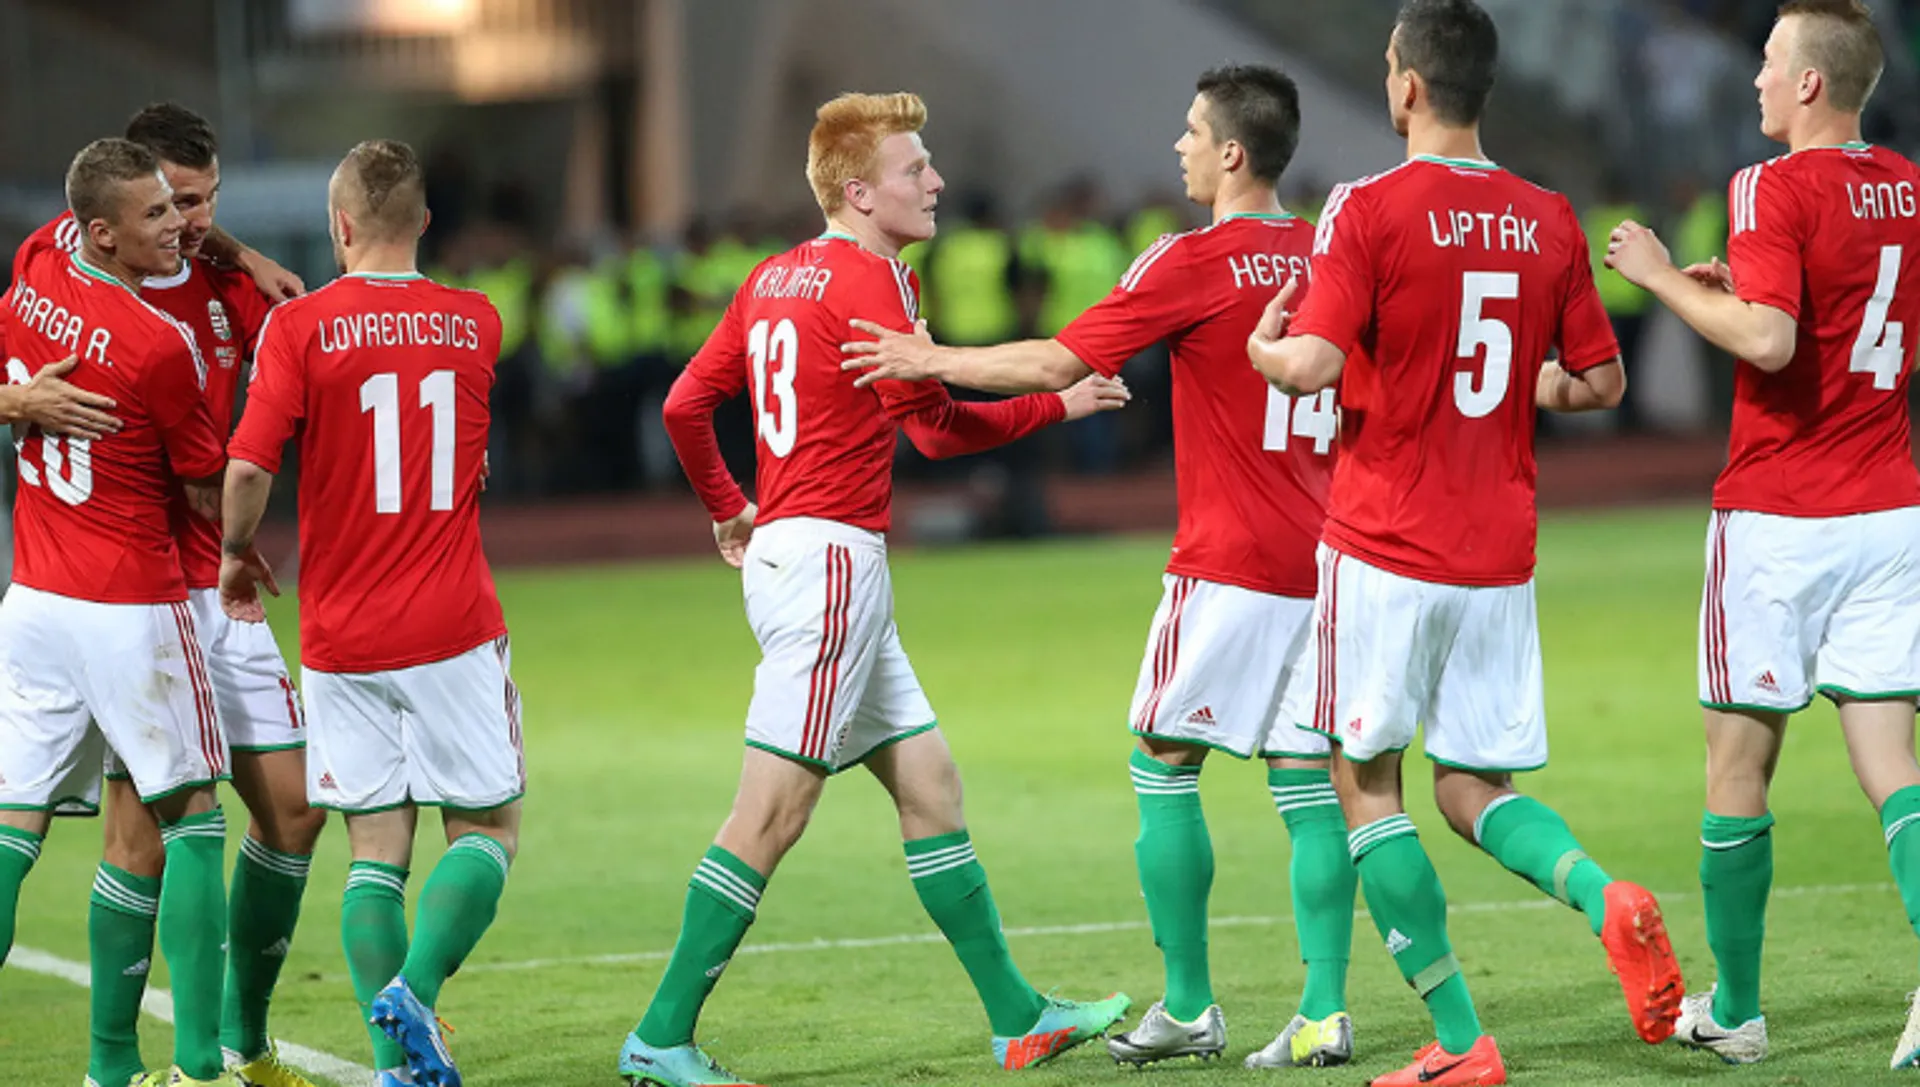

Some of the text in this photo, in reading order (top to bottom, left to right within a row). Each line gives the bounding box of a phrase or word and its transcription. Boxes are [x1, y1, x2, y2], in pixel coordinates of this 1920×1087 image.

[1846, 181, 1917, 219] LANG
[1428, 204, 1540, 255] LIPTÁK
[318, 311, 479, 353] LOVRENCSICS
[1848, 244, 1905, 391] 4
[85, 328, 113, 367] R.
[1453, 271, 1520, 419] 5
[748, 318, 799, 458] 13
[359, 370, 456, 514] 11
[1004, 1025, 1077, 1071] NIKE
